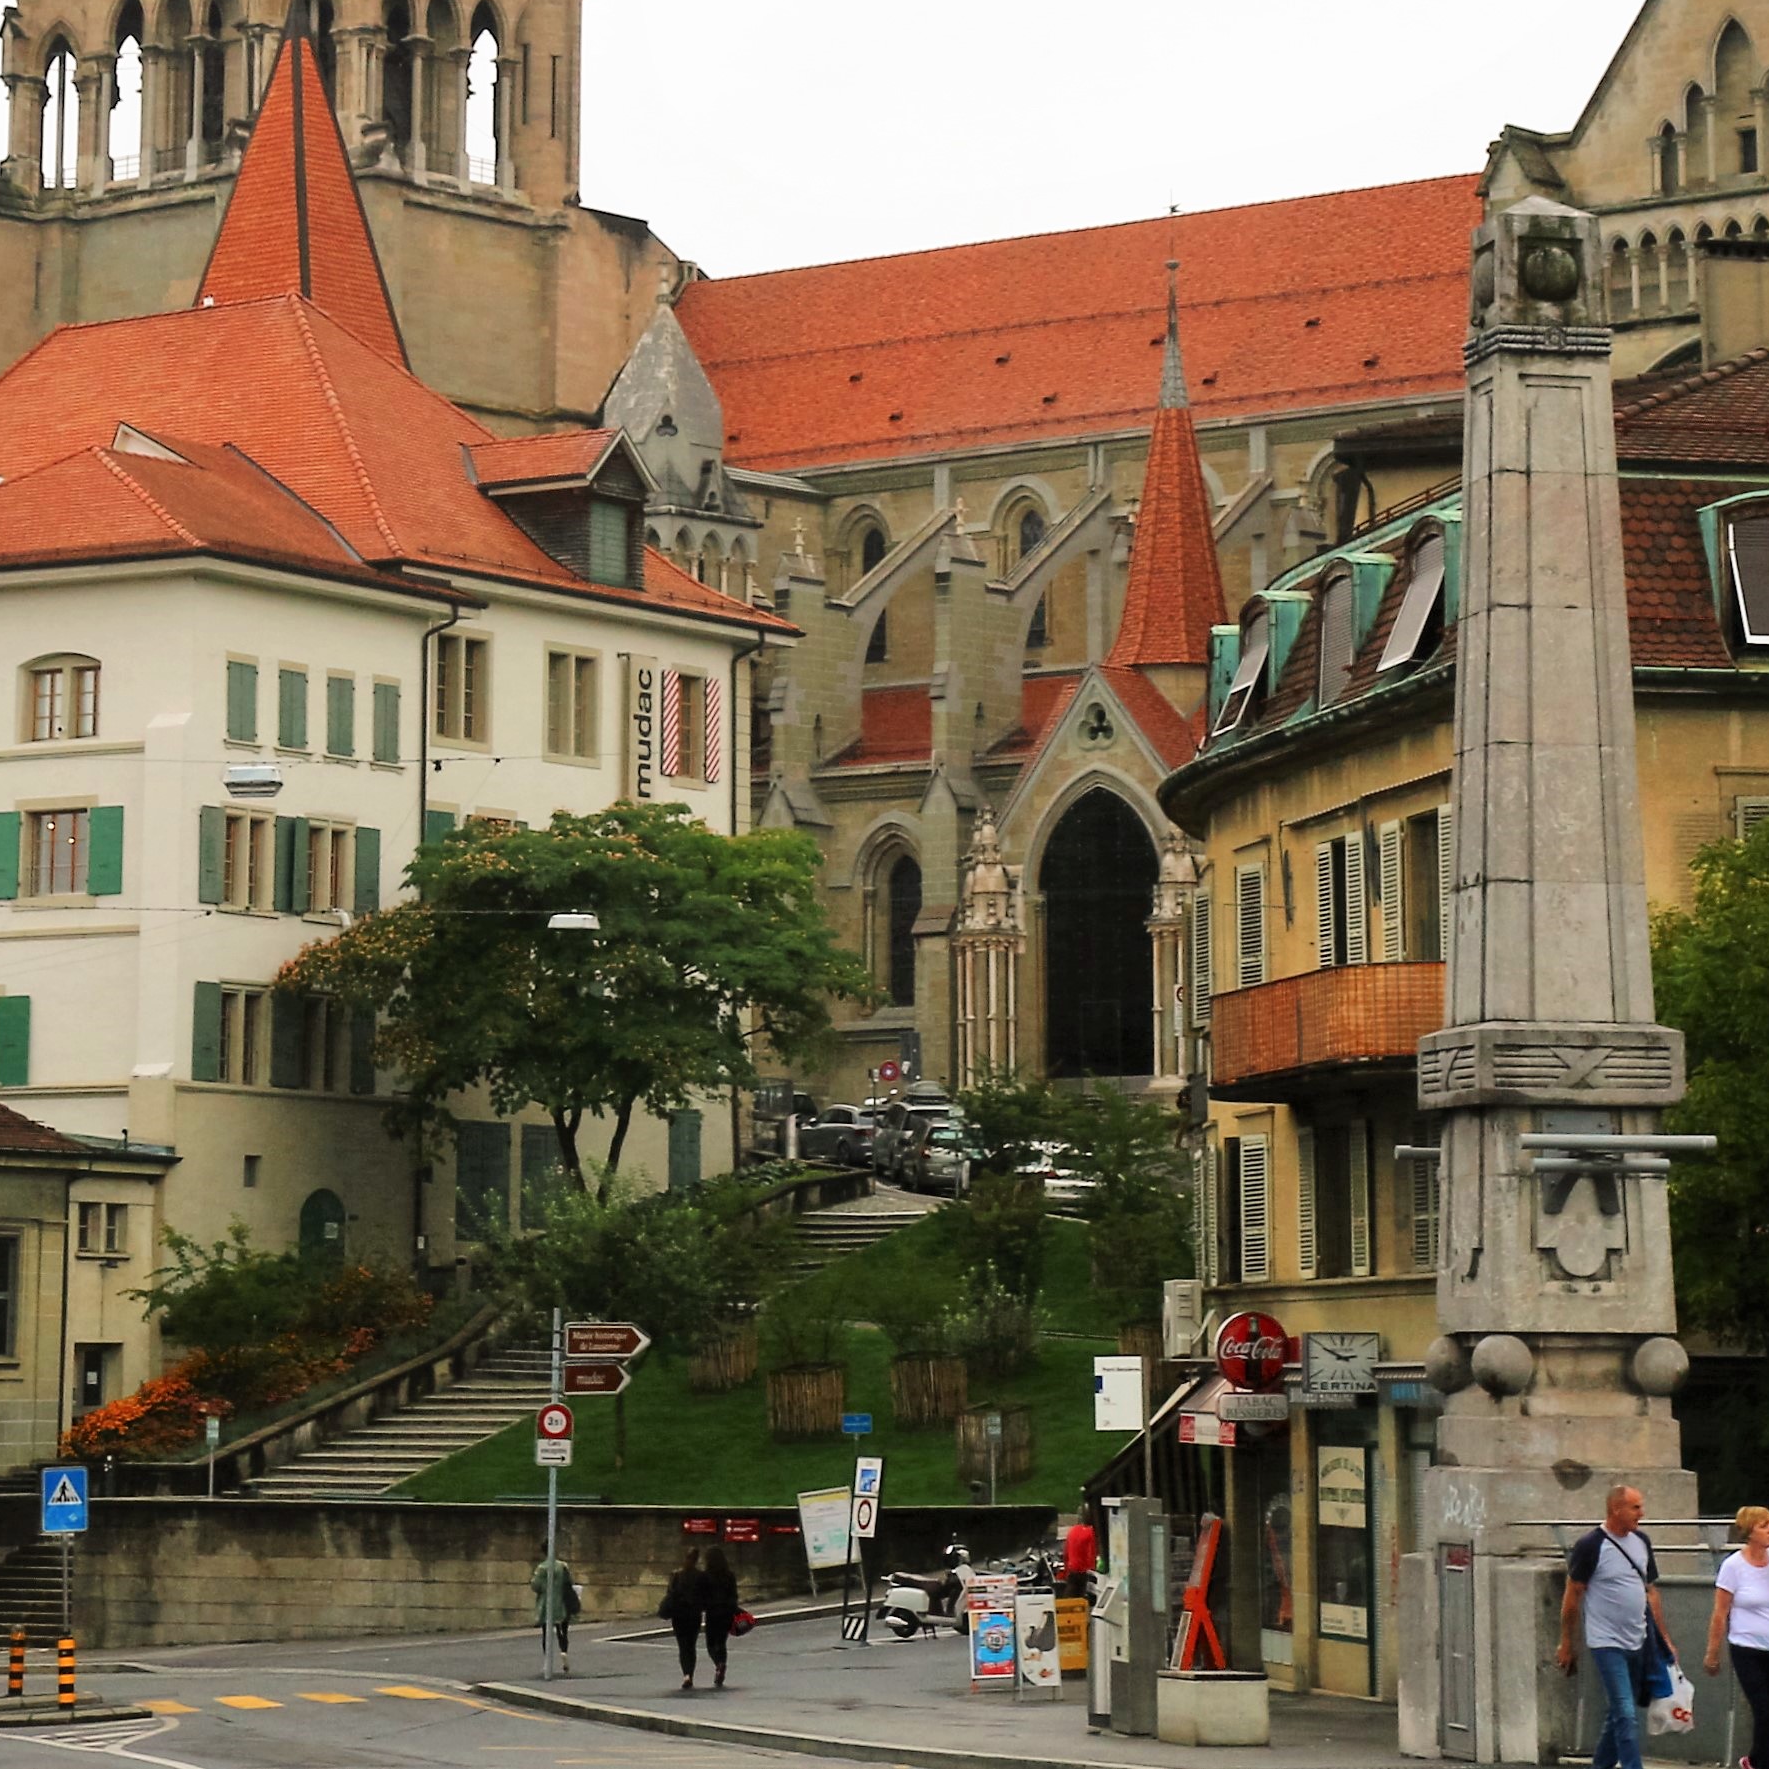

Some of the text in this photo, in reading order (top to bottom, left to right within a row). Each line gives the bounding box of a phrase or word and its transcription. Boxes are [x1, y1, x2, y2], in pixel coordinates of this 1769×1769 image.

[633, 668, 652, 798] mudac
[1219, 1335, 1283, 1360] Coca-Cola
[1310, 1381, 1377, 1391] CERTINA
[1236, 1396, 1277, 1408] TABAC
